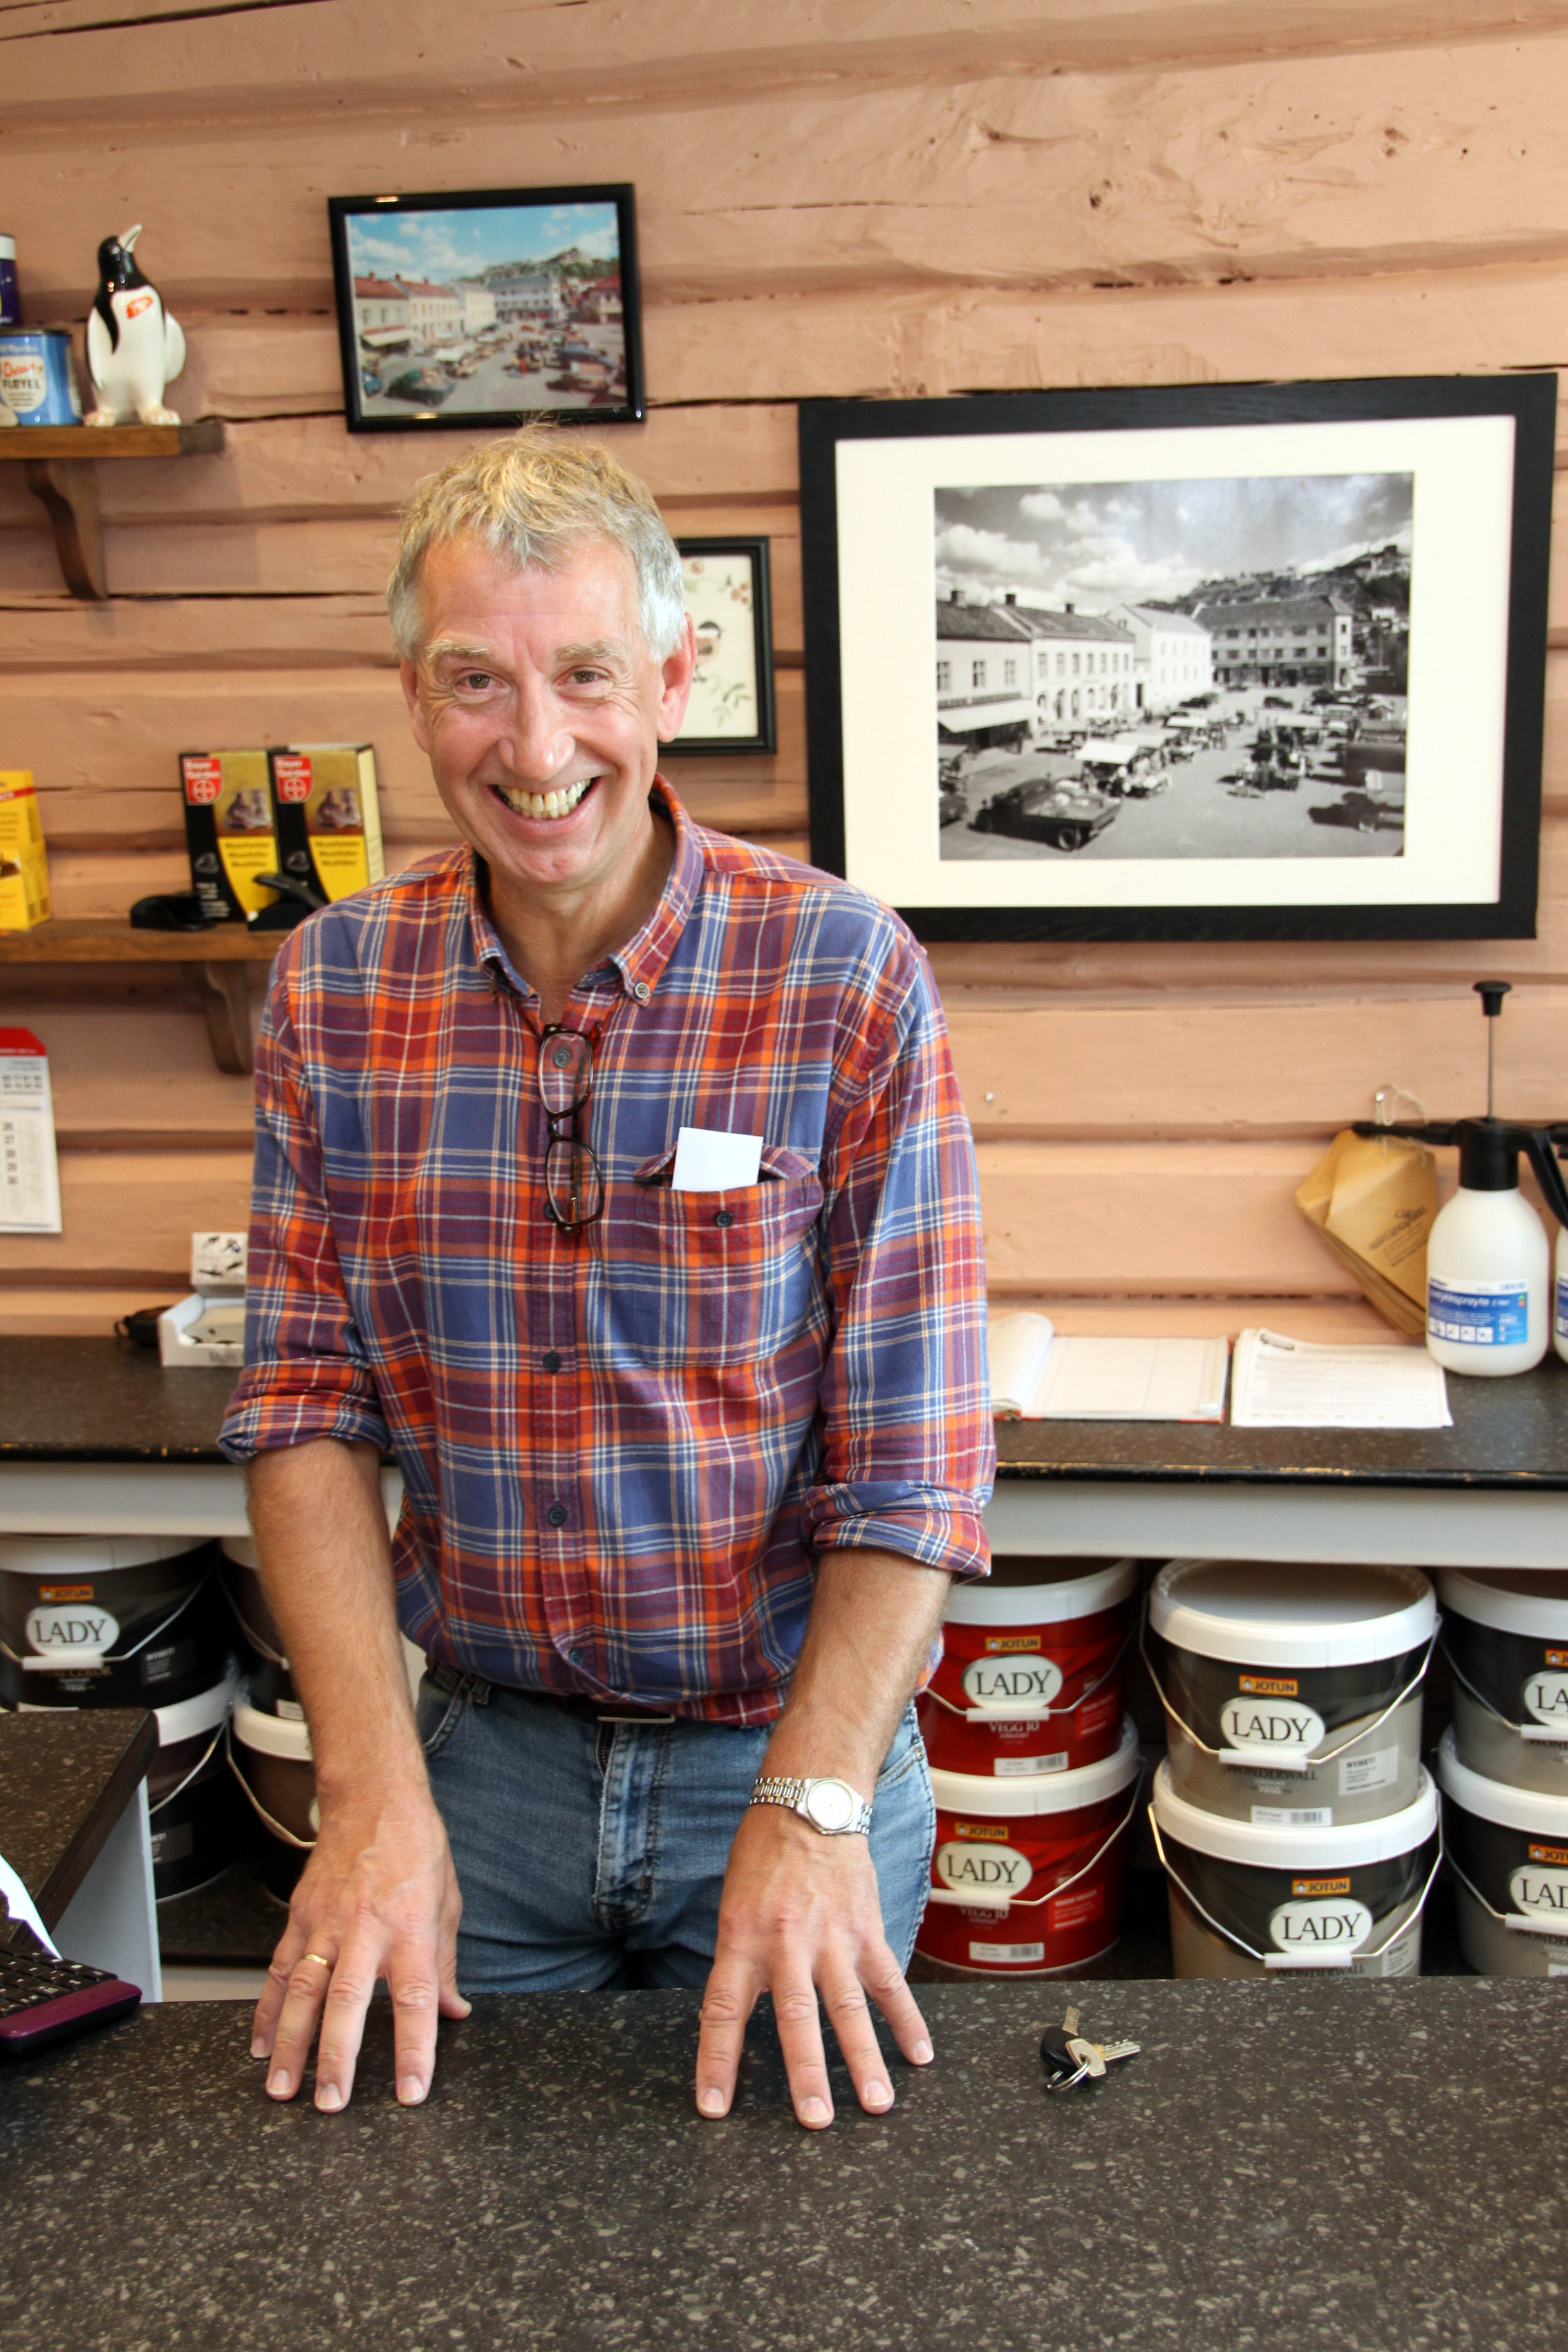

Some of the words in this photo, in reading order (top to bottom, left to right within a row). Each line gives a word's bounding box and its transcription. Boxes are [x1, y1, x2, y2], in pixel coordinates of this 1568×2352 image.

[34, 1618, 107, 1643] LADY
[1001, 1639, 1038, 1649] JOTUN
[975, 1669, 1052, 1695] LADY
[1255, 1680, 1295, 1692] JOTUN
[1535, 1685, 1568, 1712] LA
[989, 1721, 1023, 1733] VEGG
[1231, 1710, 1313, 1742] LADY
[969, 1827, 1006, 1836] JOTUN
[946, 1854, 1020, 1883] LADY
[1309, 1881, 1347, 1892] JOTUN
[1521, 1878, 1568, 1908] LAD
[1282, 1913, 1362, 1940] LADY
